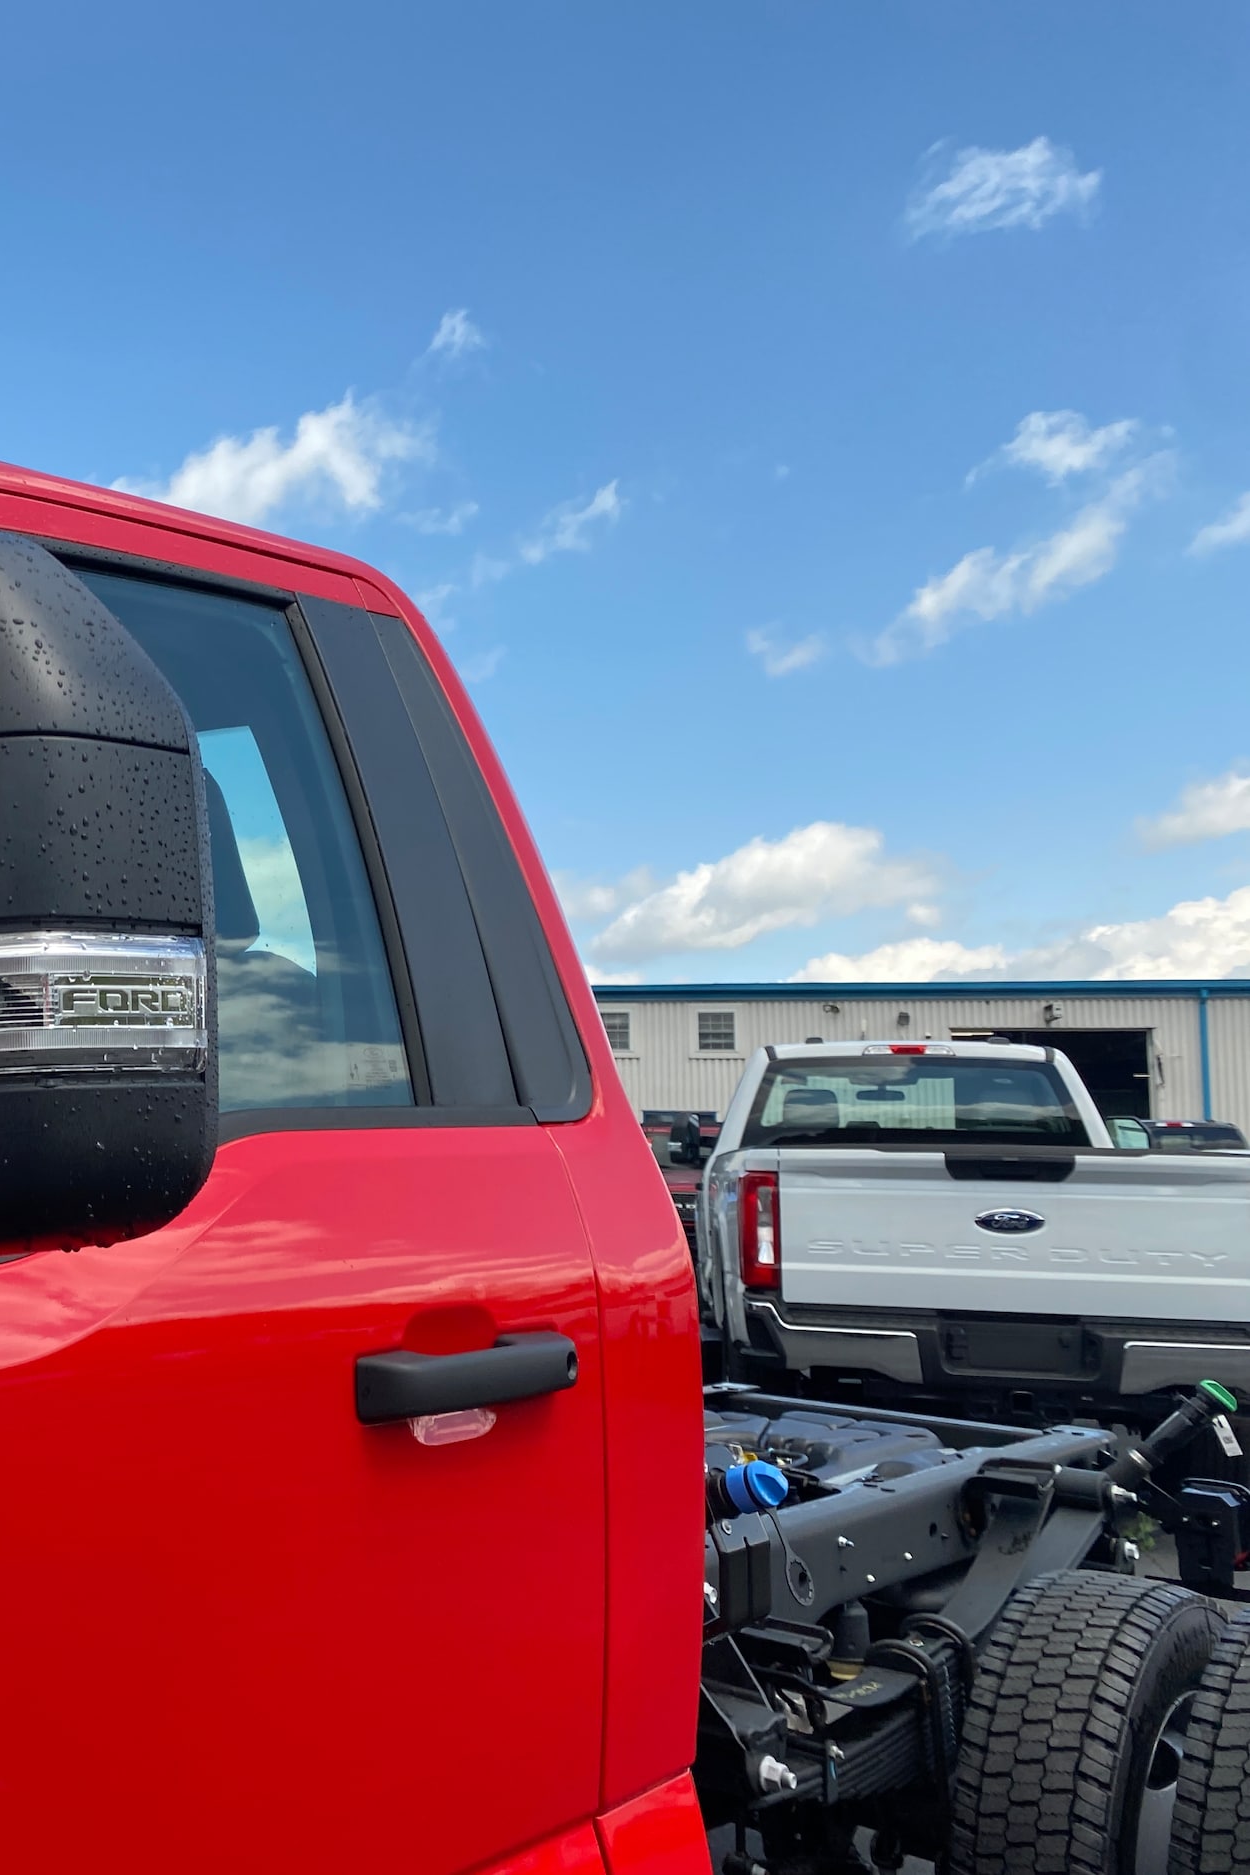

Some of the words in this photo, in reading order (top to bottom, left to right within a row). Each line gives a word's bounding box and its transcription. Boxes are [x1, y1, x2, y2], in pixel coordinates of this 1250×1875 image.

[62, 988, 188, 1014] FORD
[991, 1213, 1030, 1229] Ford
[808, 1239, 1030, 1261] SUPER
[1050, 1247, 1229, 1268] DUTY
